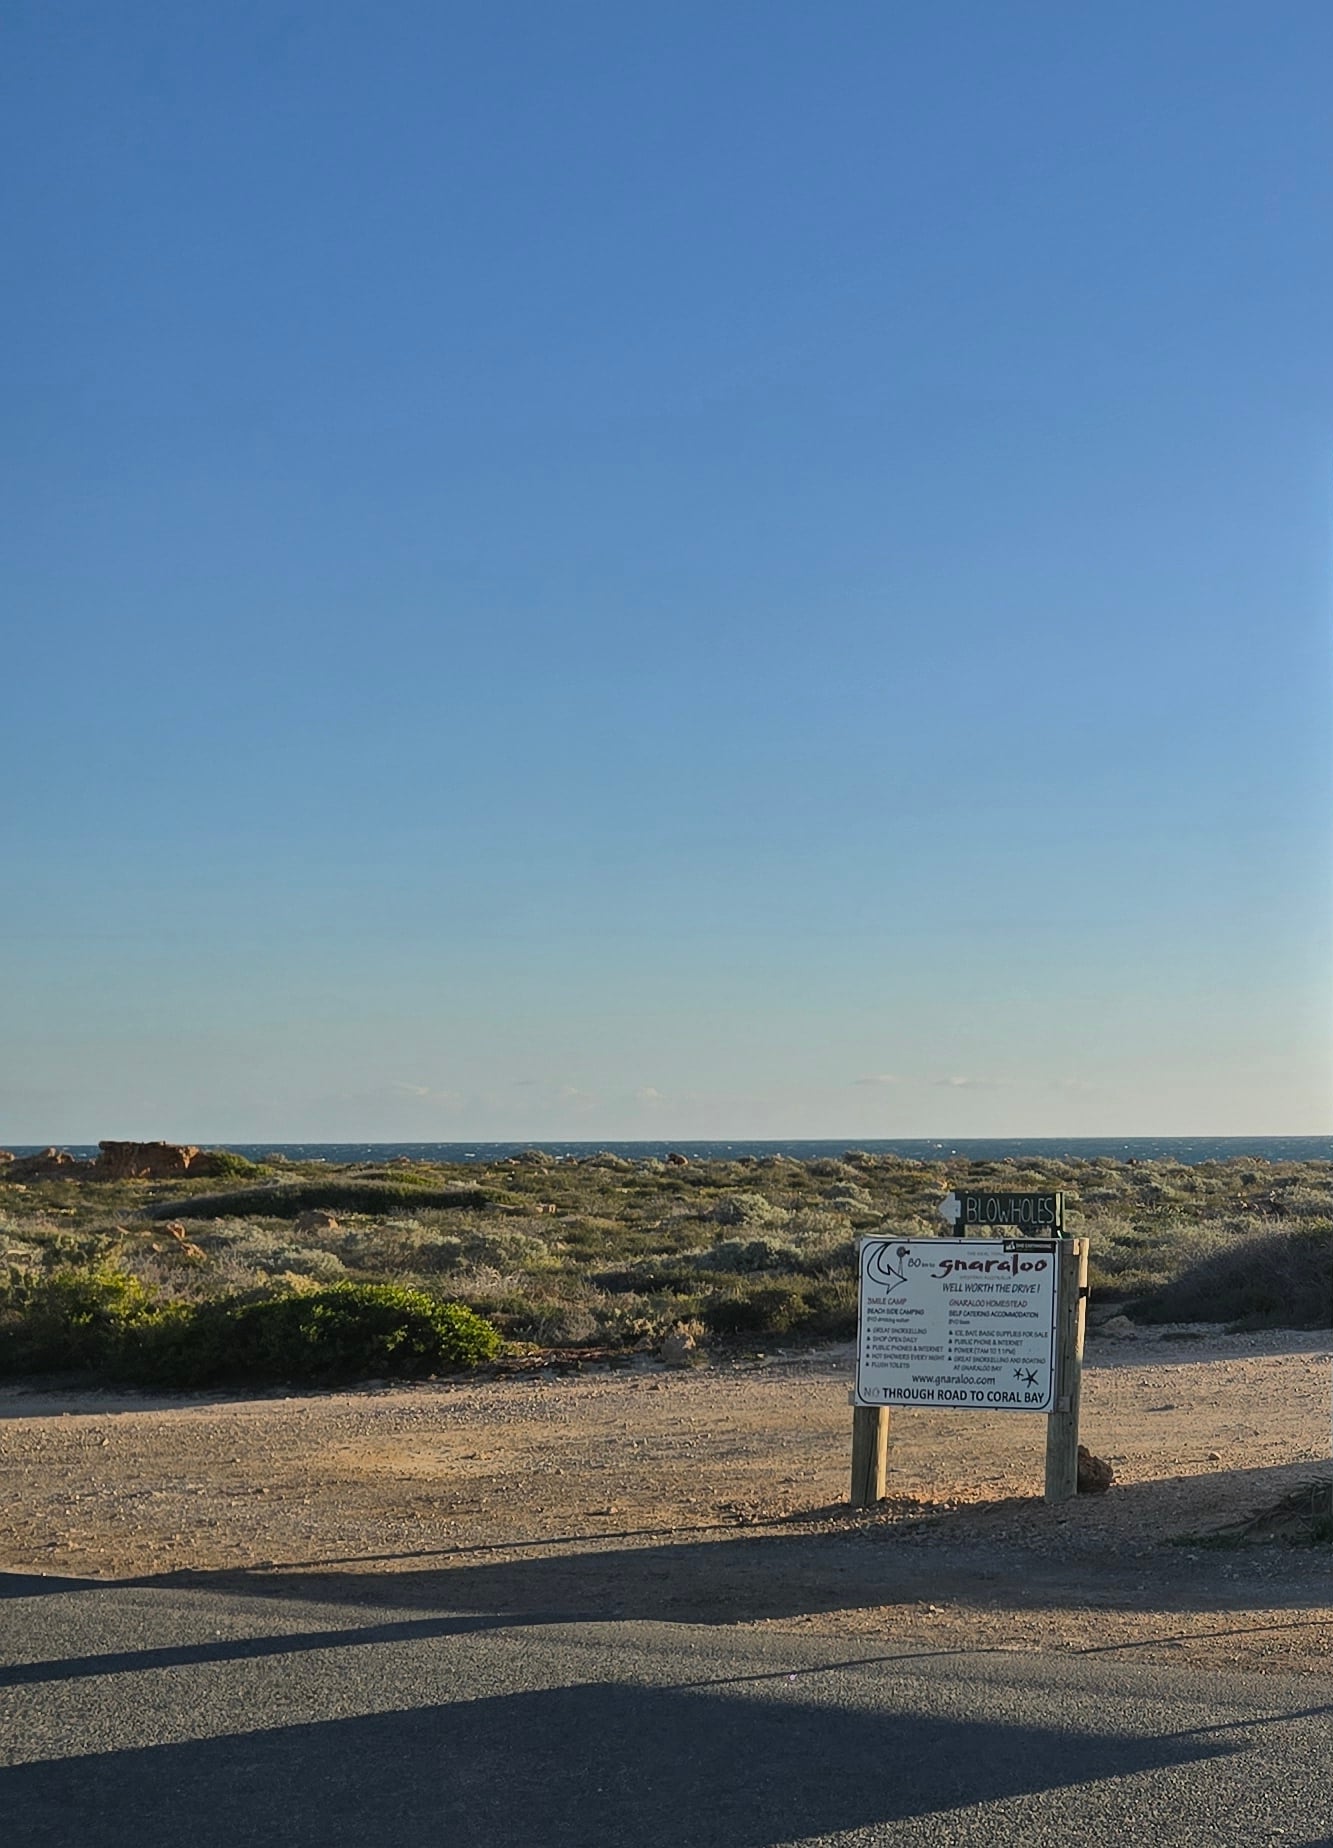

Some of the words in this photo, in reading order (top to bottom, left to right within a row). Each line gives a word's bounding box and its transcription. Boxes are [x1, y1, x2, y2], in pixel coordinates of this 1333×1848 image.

[966, 1197, 1055, 1223] BLOWHOLES
[931, 1254, 1047, 1278] gnaraloo
[943, 1283, 963, 1293] WELL
[965, 1283, 995, 1293] WORTH
[995, 1284, 1011, 1293] THE
[887, 1297, 907, 1305] CAMP
[949, 1299, 985, 1307] GNARALOO
[986, 1300, 1028, 1308] HOMESTEAD
[912, 1374, 995, 1386] www.gnaraloo.com
[883, 1387, 935, 1400] THROUGH
[938, 1389, 967, 1401] ROAD
[969, 1391, 984, 1401] TO
[987, 1391, 1021, 1402] CORAL
[1025, 1392, 1045, 1403] BAY
